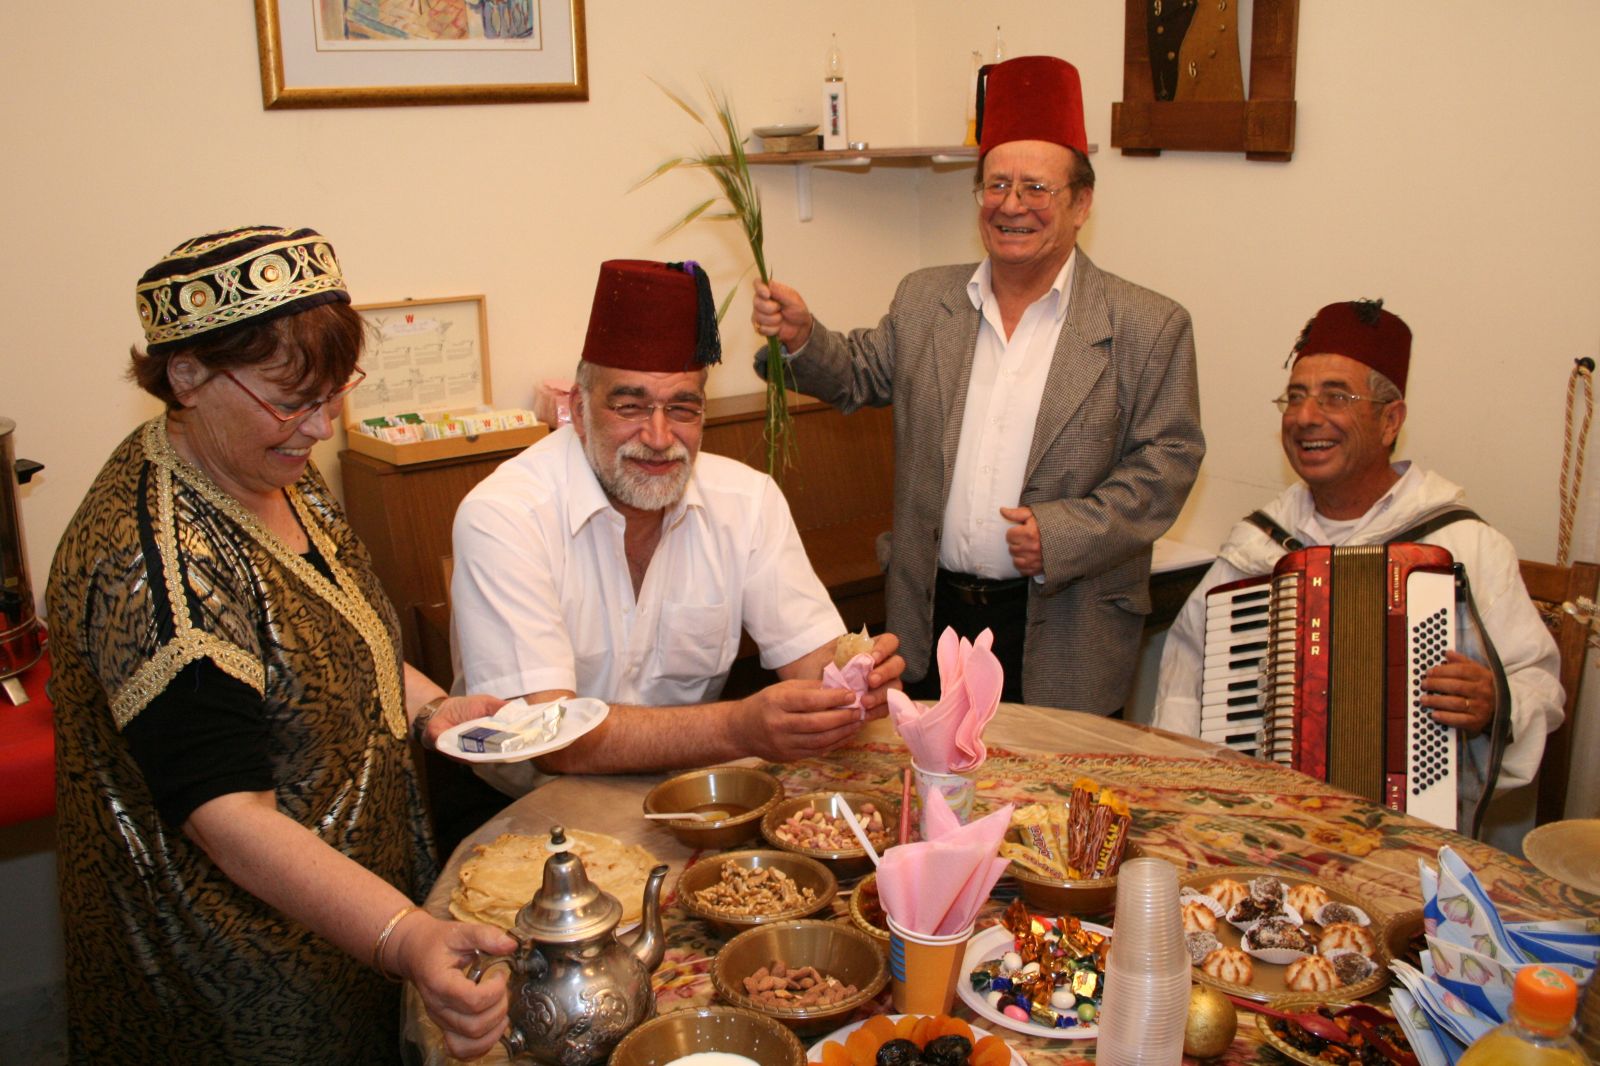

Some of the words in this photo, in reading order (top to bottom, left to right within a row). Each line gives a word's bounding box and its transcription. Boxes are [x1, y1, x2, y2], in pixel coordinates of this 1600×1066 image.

[1153, 0, 1161, 16] 9
[1188, 59, 1197, 78] 6
[405, 314, 414, 324] W
[482, 419, 491, 428] W
[515, 415, 524, 423] W
[447, 423, 456, 431] W
